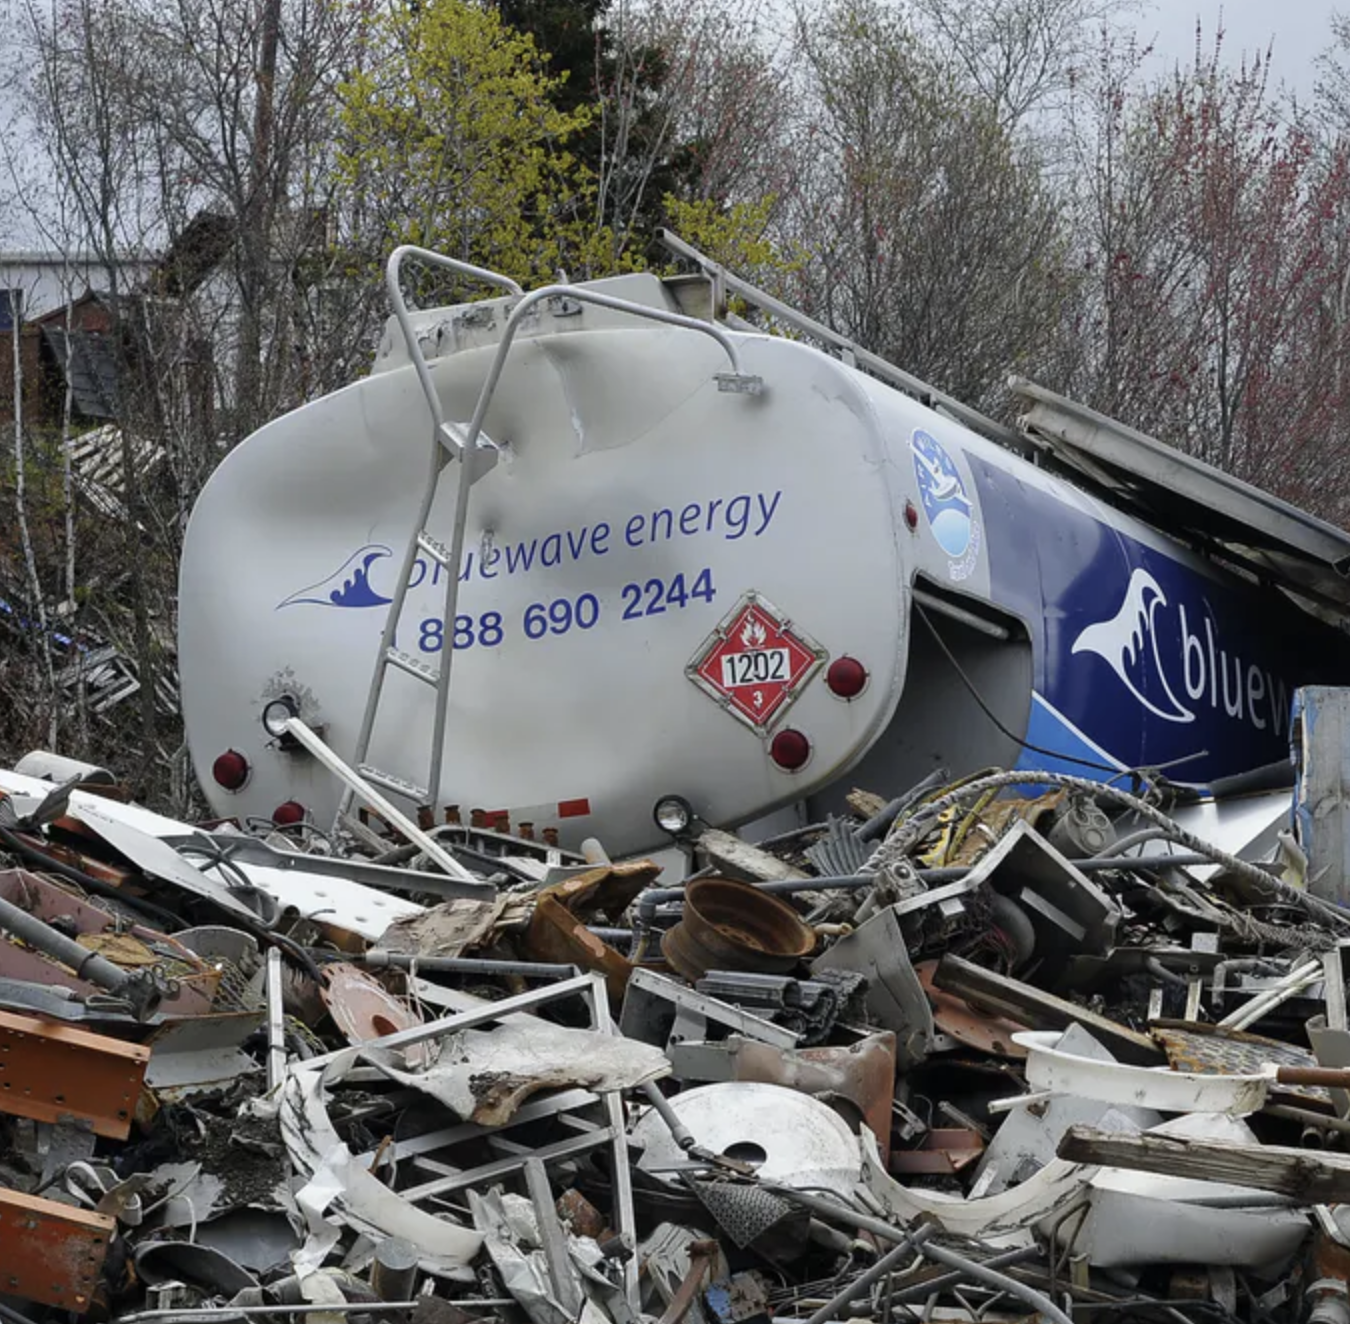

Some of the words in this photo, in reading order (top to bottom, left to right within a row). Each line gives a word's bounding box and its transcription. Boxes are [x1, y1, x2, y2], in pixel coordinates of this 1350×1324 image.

[625, 490, 782, 547] energy
[418, 611, 504, 653] 888
[523, 593, 599, 640] 690
[621, 568, 717, 621] 2244
[726, 650, 785, 684] 1202
[752, 690, 763, 709] 3
